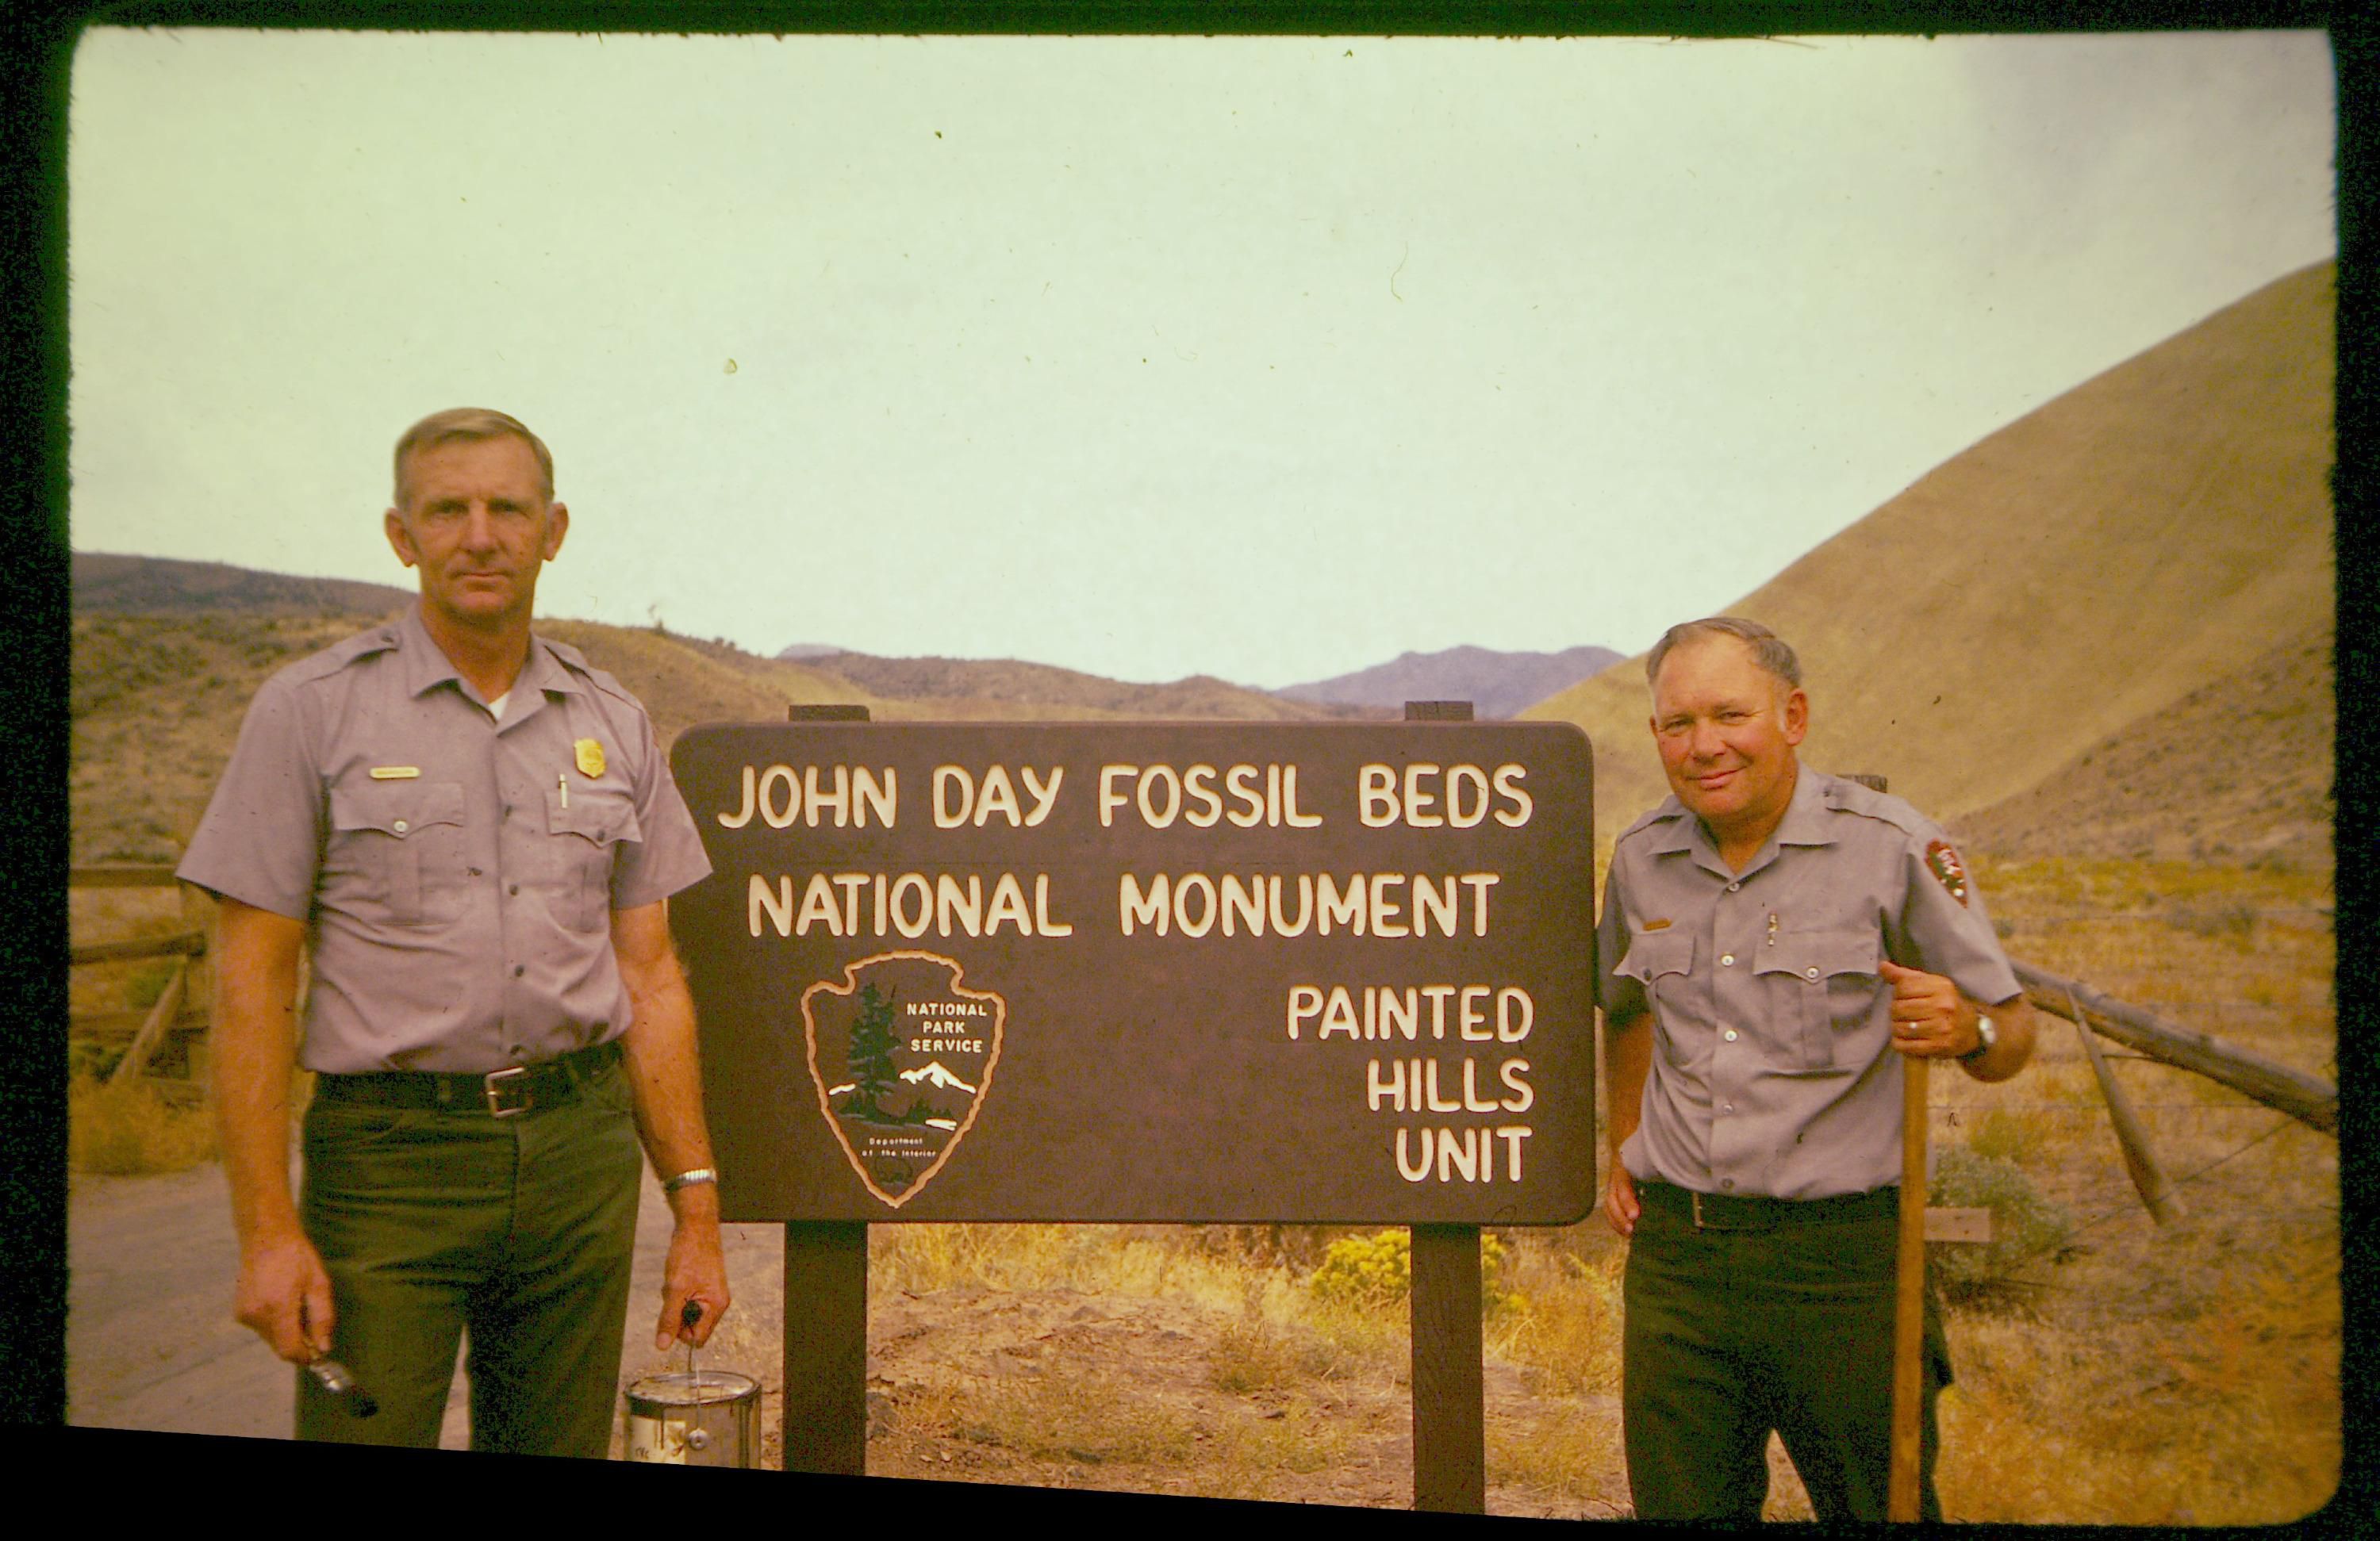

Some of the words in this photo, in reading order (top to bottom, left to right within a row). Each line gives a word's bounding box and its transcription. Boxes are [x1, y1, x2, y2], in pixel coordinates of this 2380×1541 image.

[717, 765, 896, 829] JOHN
[932, 765, 1064, 829] DAY
[1098, 765, 1322, 830] FOSSIL
[1358, 765, 1534, 830] BEDS
[748, 873, 1073, 939] NATIONAL
[1119, 873, 1500, 939] MONUMENT
[907, 1002, 988, 1018] NATIONAL
[923, 1020, 965, 1034] PARK
[1287, 987, 1534, 1044] PAINTED
[910, 1039, 983, 1053] SERVICE
[1367, 1059, 1534, 1114] HILLS
[1395, 1126, 1534, 1184] UNIT
